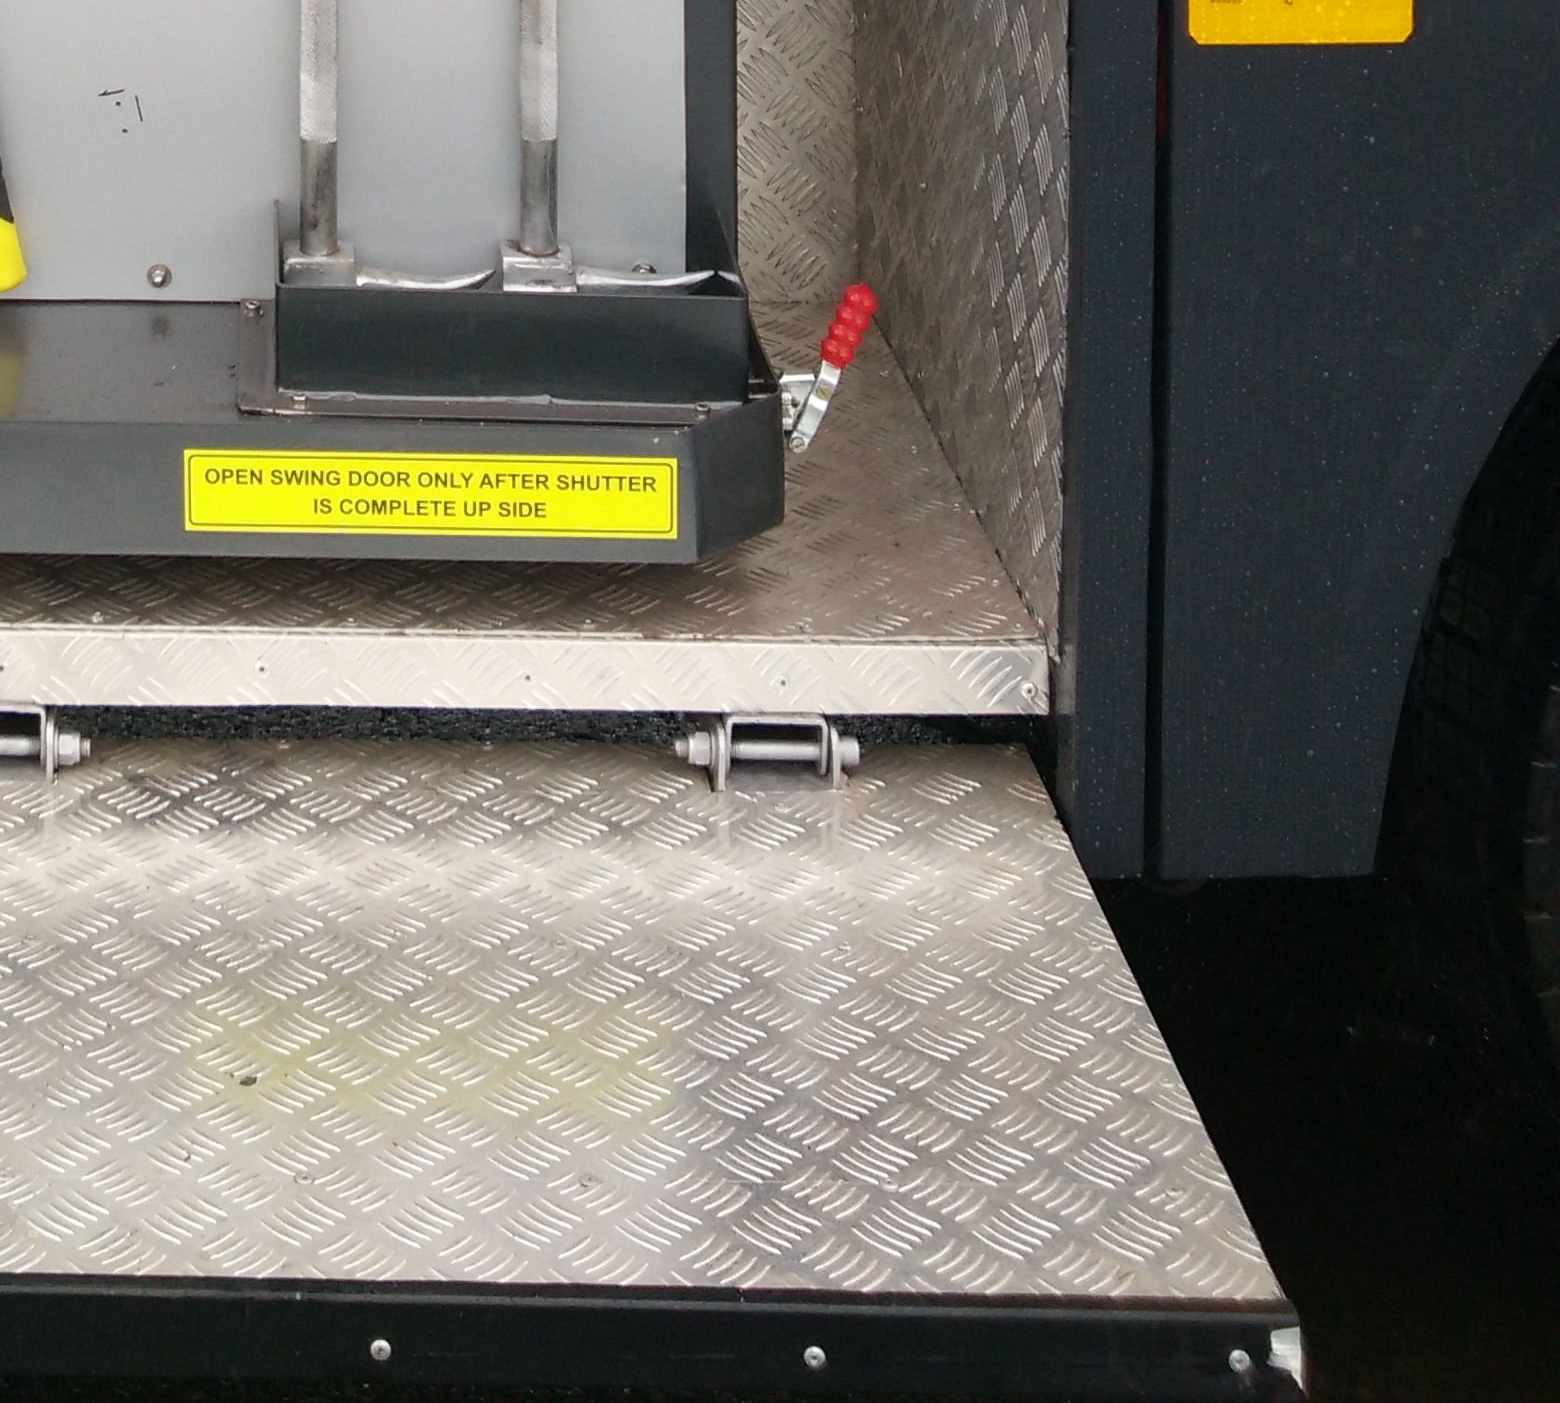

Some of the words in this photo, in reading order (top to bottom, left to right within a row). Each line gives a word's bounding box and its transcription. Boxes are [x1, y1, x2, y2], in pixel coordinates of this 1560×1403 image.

[205, 468, 262, 486] OPEN
[270, 469, 341, 487] SWING
[348, 470, 410, 488] DOOR
[418, 471, 473, 489] ONLY
[480, 472, 549, 490] AFTER
[556, 473, 657, 493] SHUTTER
[313, 498, 332, 515] IS
[339, 499, 456, 517] COMPLETE
[463, 500, 491, 517] UP
[498, 501, 547, 519] SIDE
